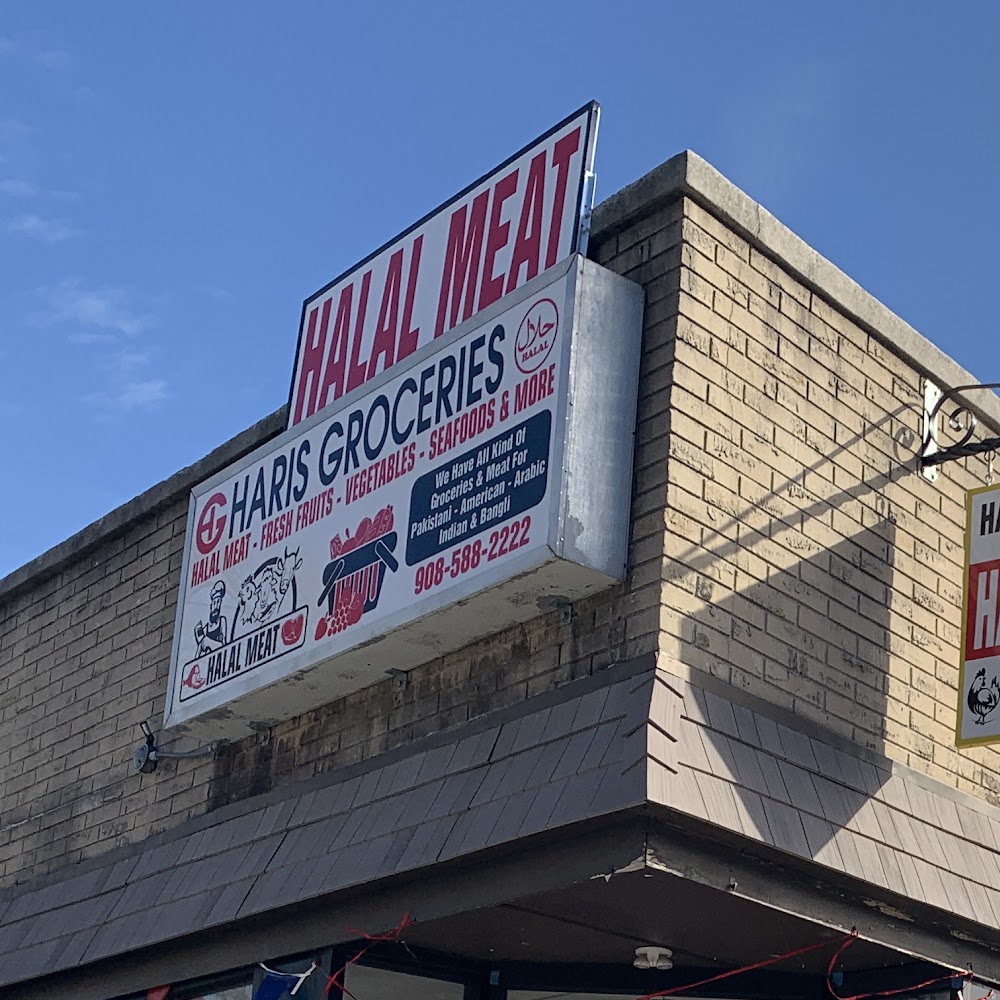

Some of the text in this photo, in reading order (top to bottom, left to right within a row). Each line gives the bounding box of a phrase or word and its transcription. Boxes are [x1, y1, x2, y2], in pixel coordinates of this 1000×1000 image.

[293, 126, 581, 425] HALAL MEAT
[522, 340, 549, 363] HALAL
[228, 324, 505, 539] HARIS GROCERIES
[435, 426, 526, 489] We Have All Kind Of
[191, 550, 220, 588] HALAL
[223, 532, 251, 568] MEAT
[260, 510, 293, 551] FRESH
[295, 487, 334, 532] FRUITS
[345, 442, 416, 506] VEGETABLES
[428, 398, 495, 461] SEAFOODS
[500, 391, 509, 421] &
[513, 363, 555, 415] MORE
[410, 505, 452, 539] Pakistani
[460, 481, 505, 515] American
[514, 459, 546, 488] Arabic
[430, 449, 528, 510] Groceries & Meat For
[414, 515, 531, 595] 908-588-2222
[438, 495, 511, 545] Indian & Bangli
[205, 624, 280, 685] HALAL MEAT
